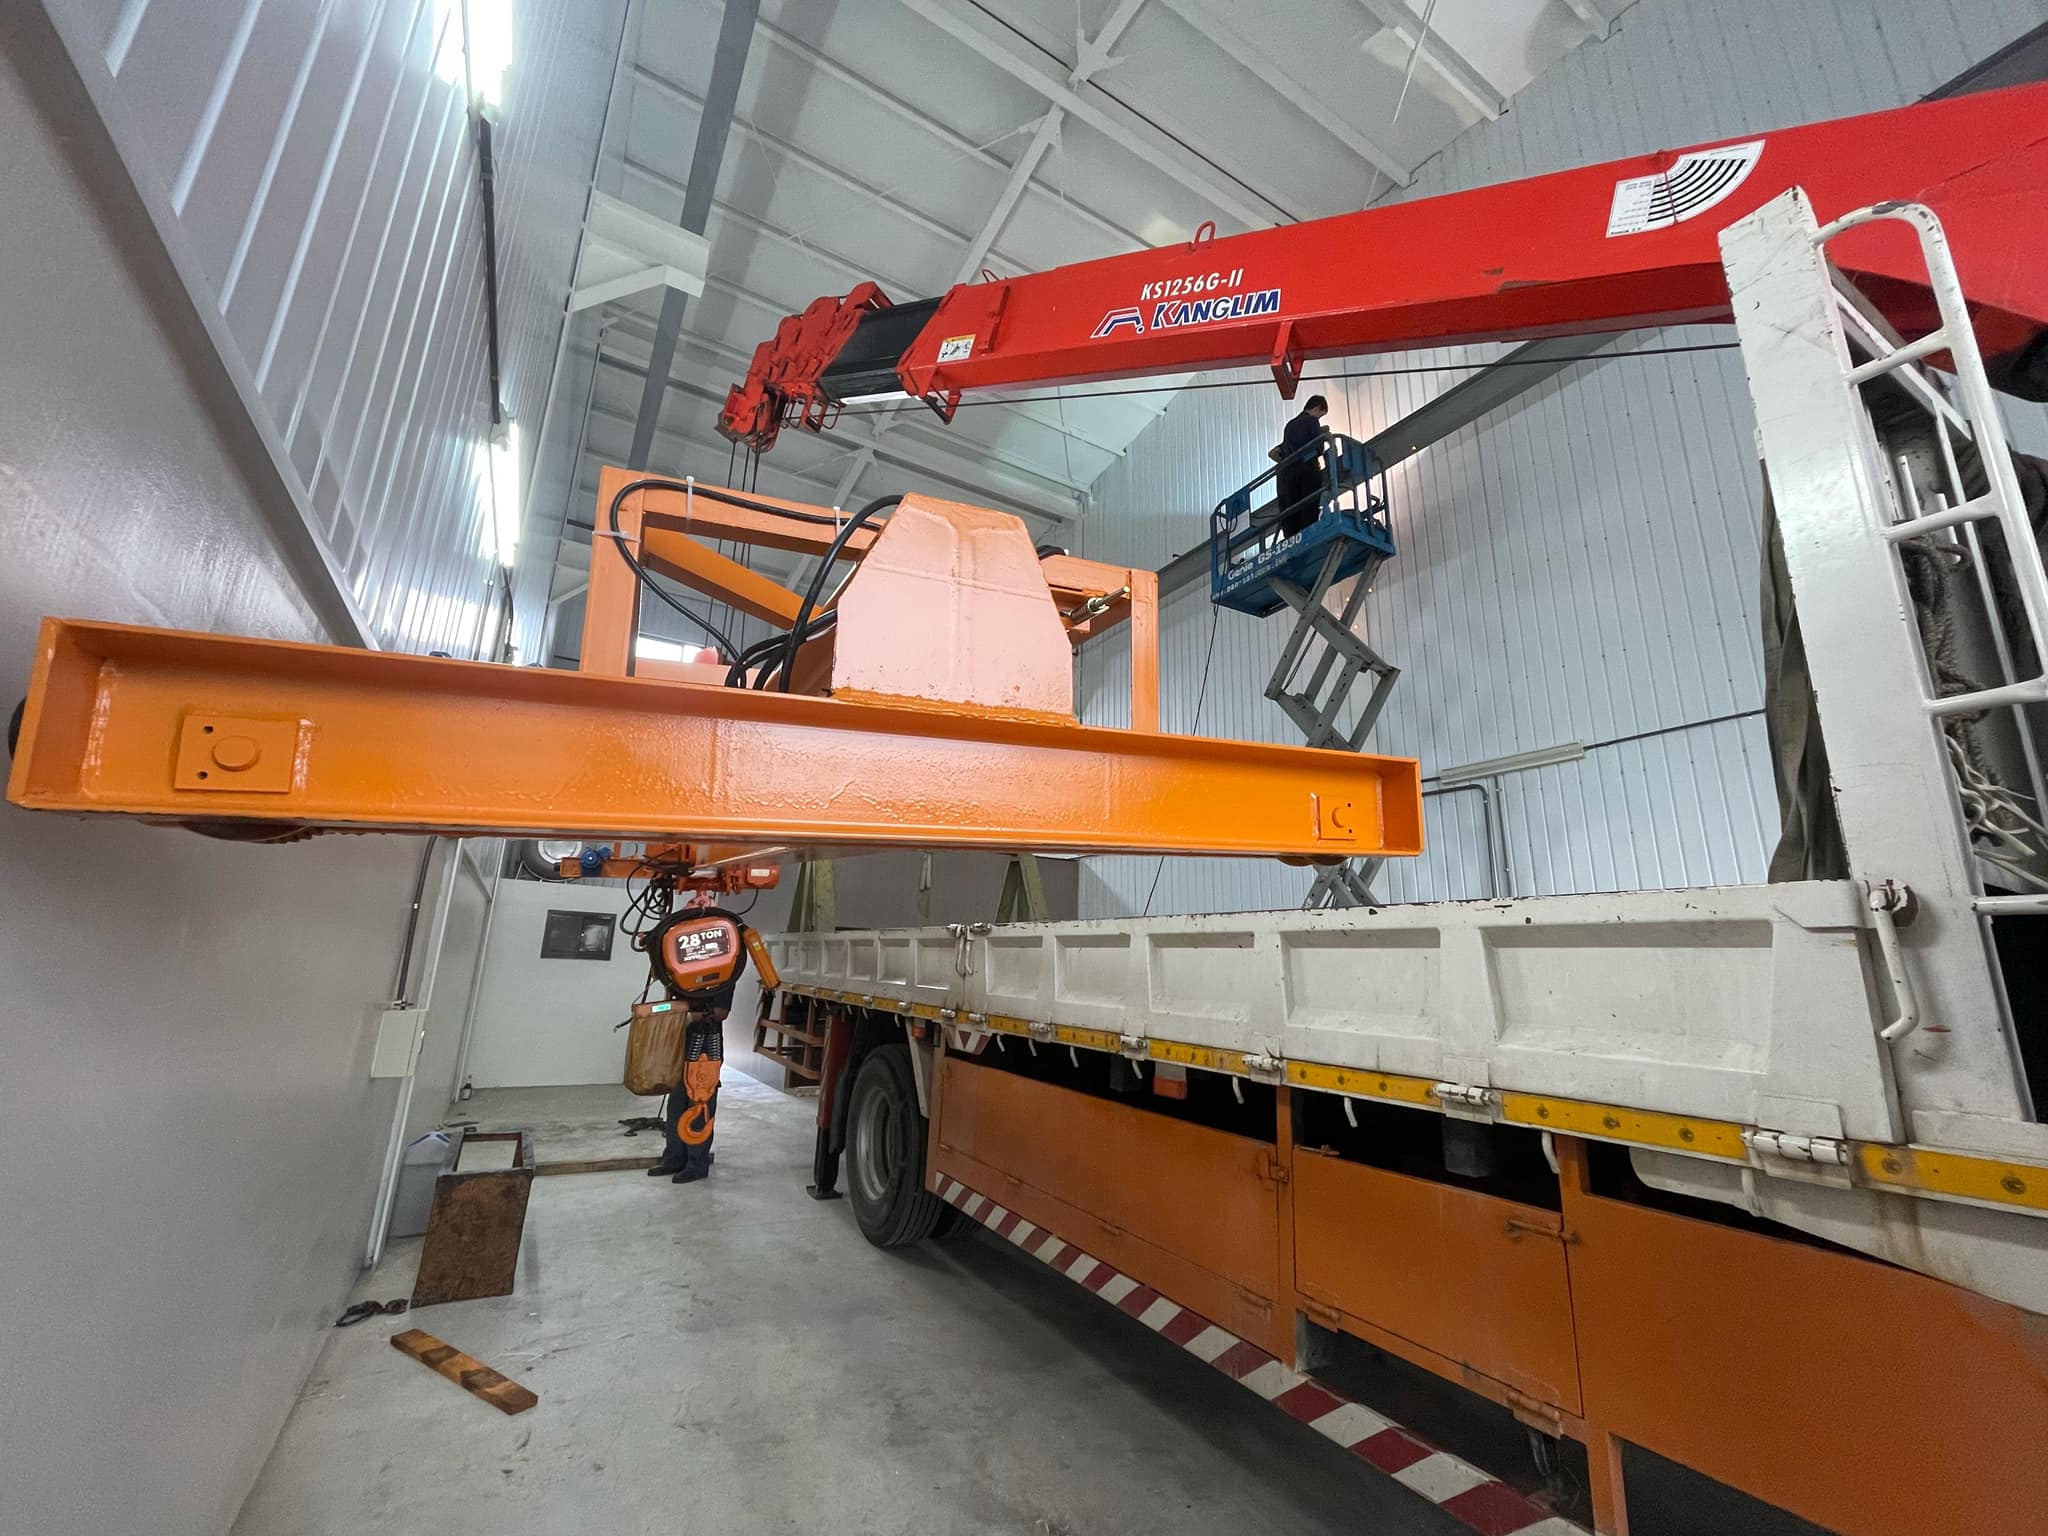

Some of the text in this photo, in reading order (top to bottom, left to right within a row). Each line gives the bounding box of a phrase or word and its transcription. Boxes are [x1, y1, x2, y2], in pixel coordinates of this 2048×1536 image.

[1141, 269, 1244, 301] KS1256G-II
[1151, 288, 1282, 330] KANGLIM
[1228, 560, 1254, 580] Genie
[700, 930, 722, 940] TON
